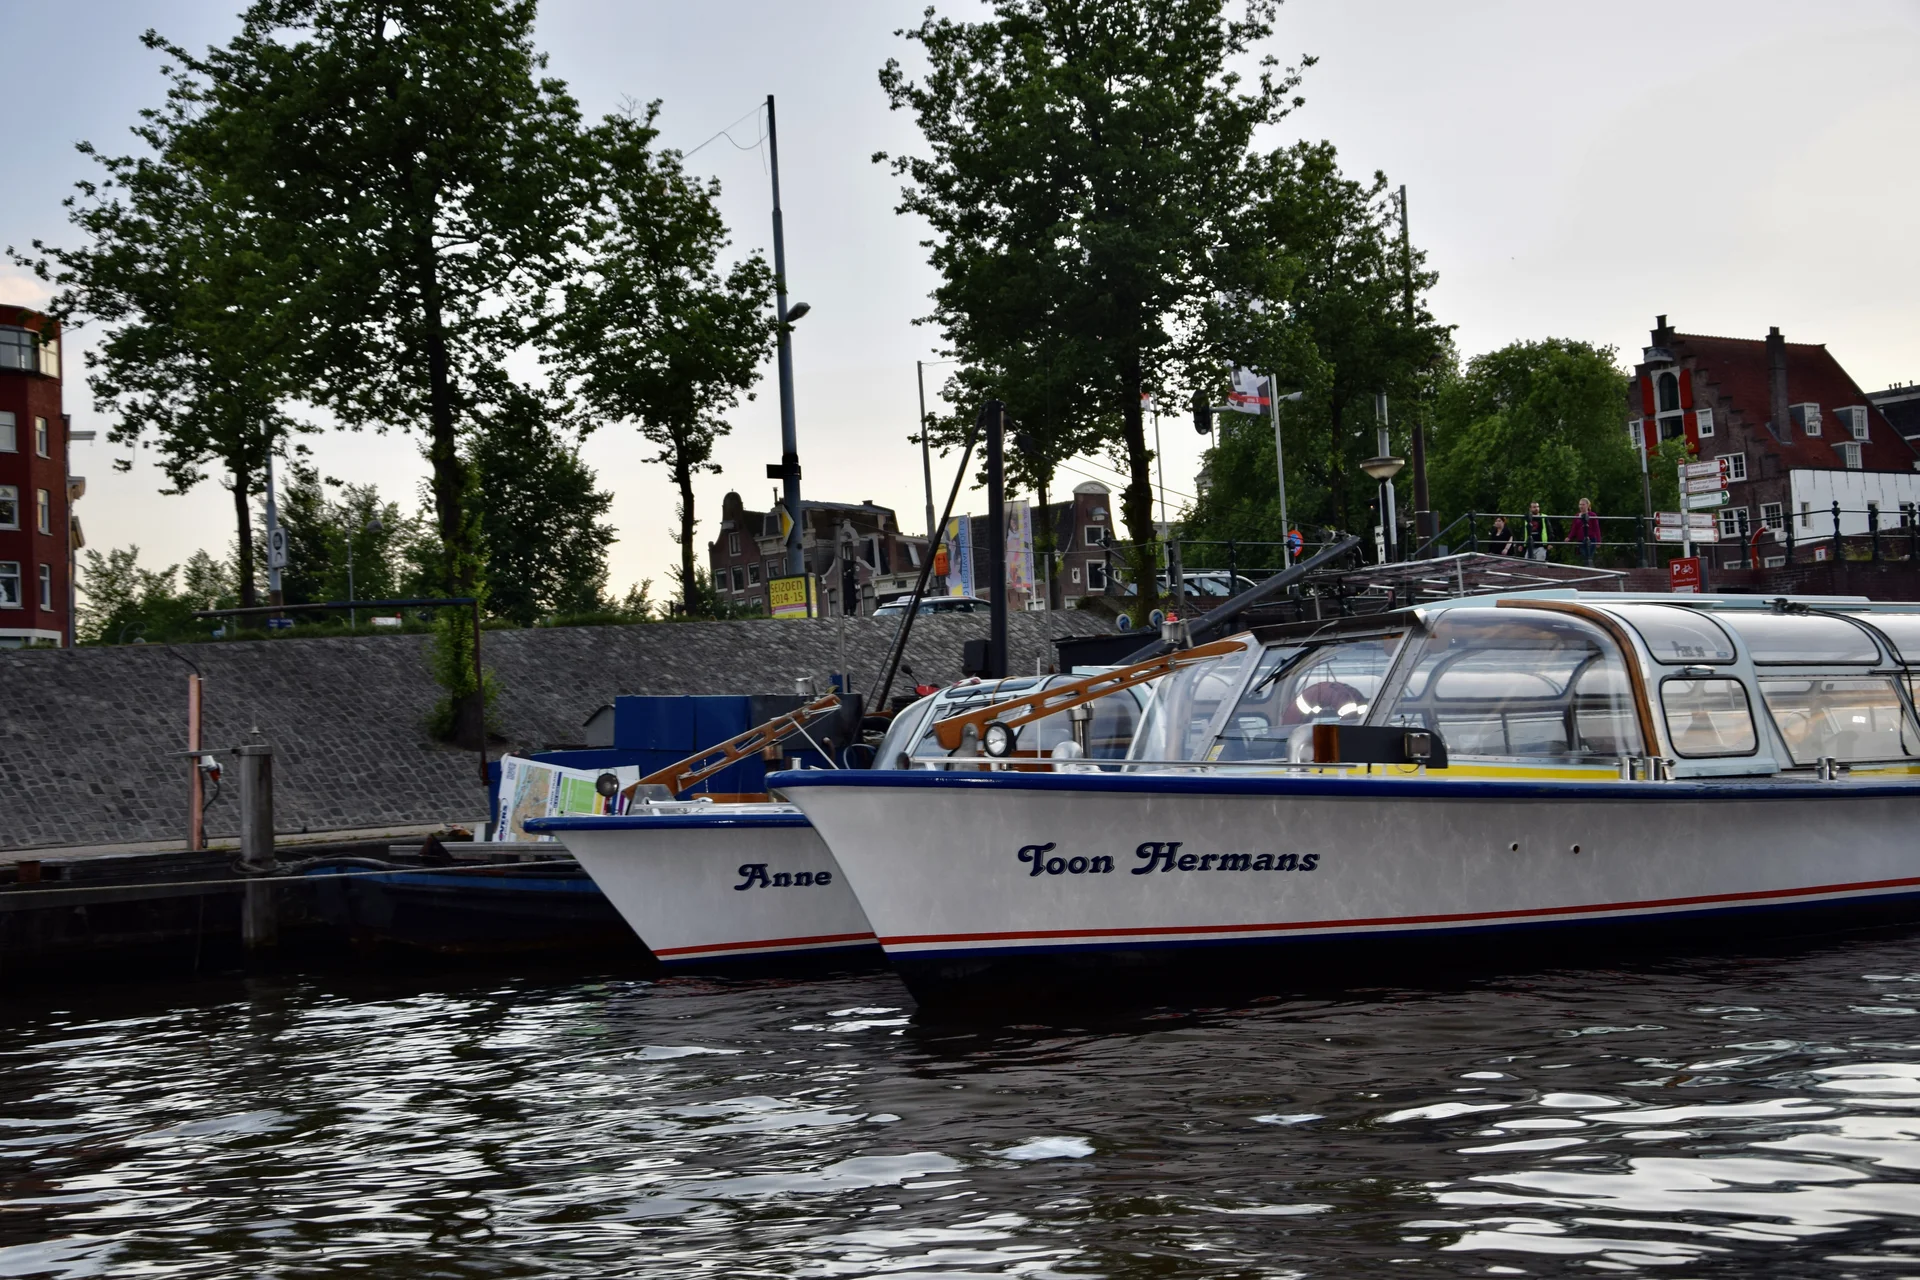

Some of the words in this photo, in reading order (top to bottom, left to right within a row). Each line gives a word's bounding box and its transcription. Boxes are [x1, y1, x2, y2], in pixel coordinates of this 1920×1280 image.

[1673, 564, 1680, 576] P
[771, 580, 803, 593] SEIZOEN
[1018, 842, 1115, 877] Toon
[1131, 841, 1320, 875] Hermans
[734, 863, 832, 891] Anne
